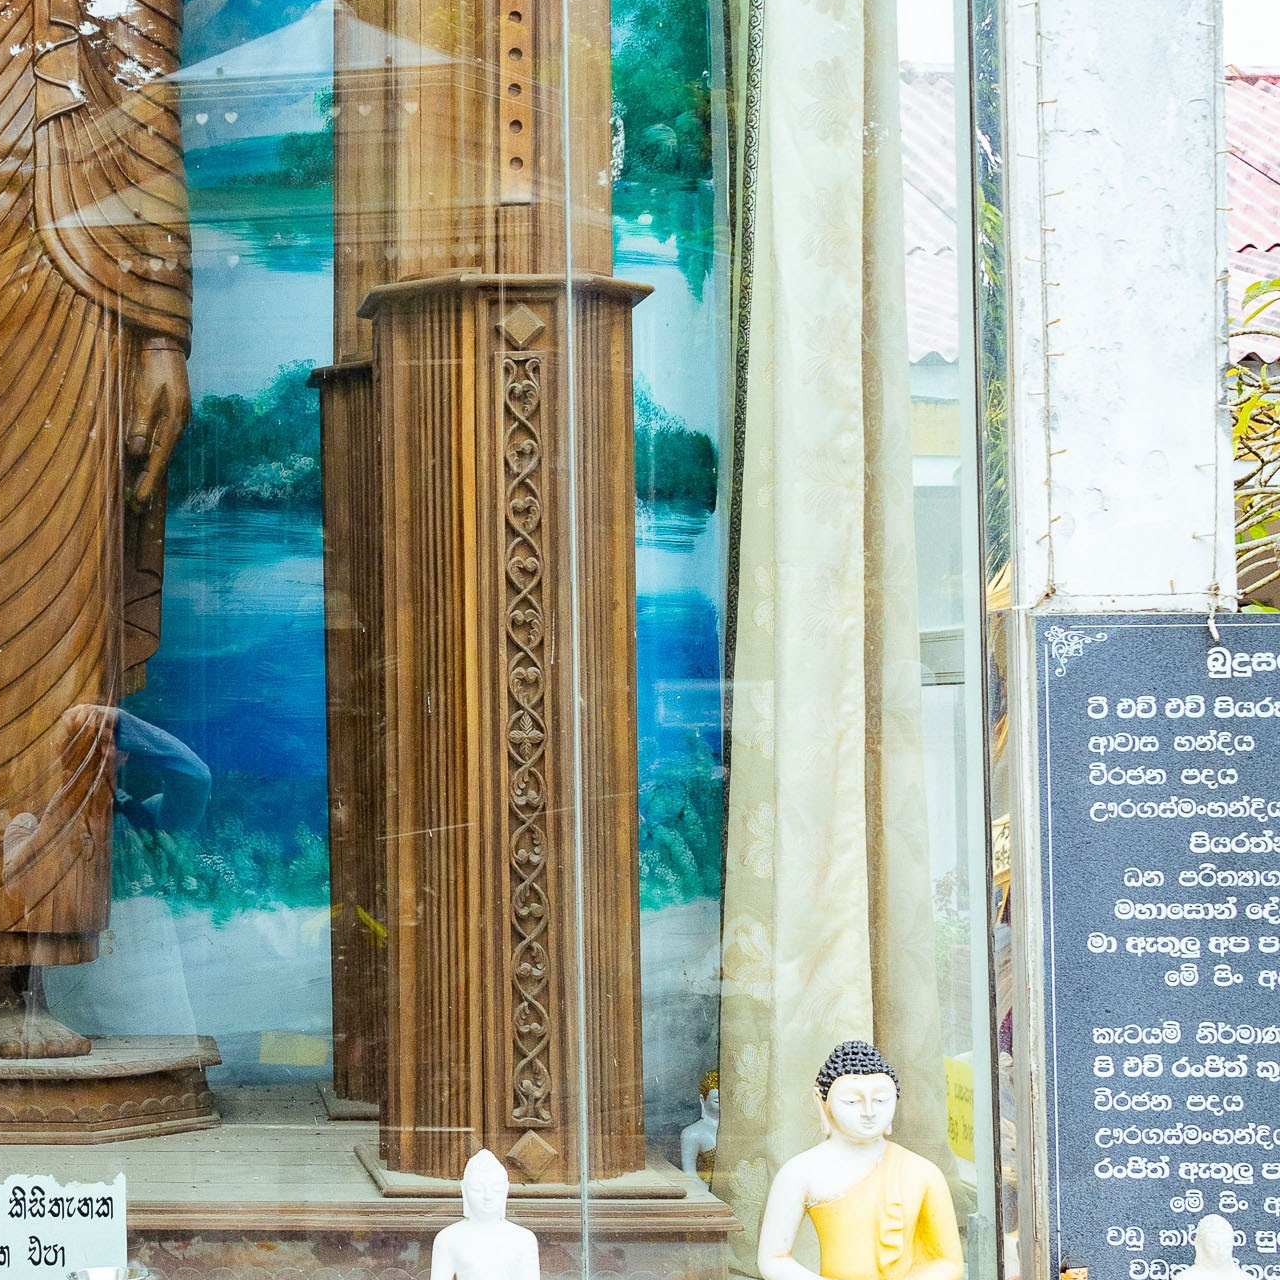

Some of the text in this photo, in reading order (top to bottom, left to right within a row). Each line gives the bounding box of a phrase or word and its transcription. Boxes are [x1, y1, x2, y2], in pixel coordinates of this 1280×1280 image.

[1206, 646, 1280, 679] බුදුස
[1088, 729, 1255, 756] ආවාස හන්දිය
[1180, 768, 1238, 790] පදය
[1123, 867, 1165, 887] ධන
[1114, 896, 1237, 920] මහාසොන්
[1087, 932, 1118, 953] මා
[1208, 936, 1250, 957] අප
[1164, 962, 1199, 987] මේ
[1213, 964, 1244, 987] පිං
[1186, 1094, 1244, 1116] පදය
[1169, 1189, 1204, 1213] මේ
[1218, 1190, 1249, 1214] පිං
[1106, 1226, 1145, 1251] වඩු
[27, 1235, 66, 1268] එපා
